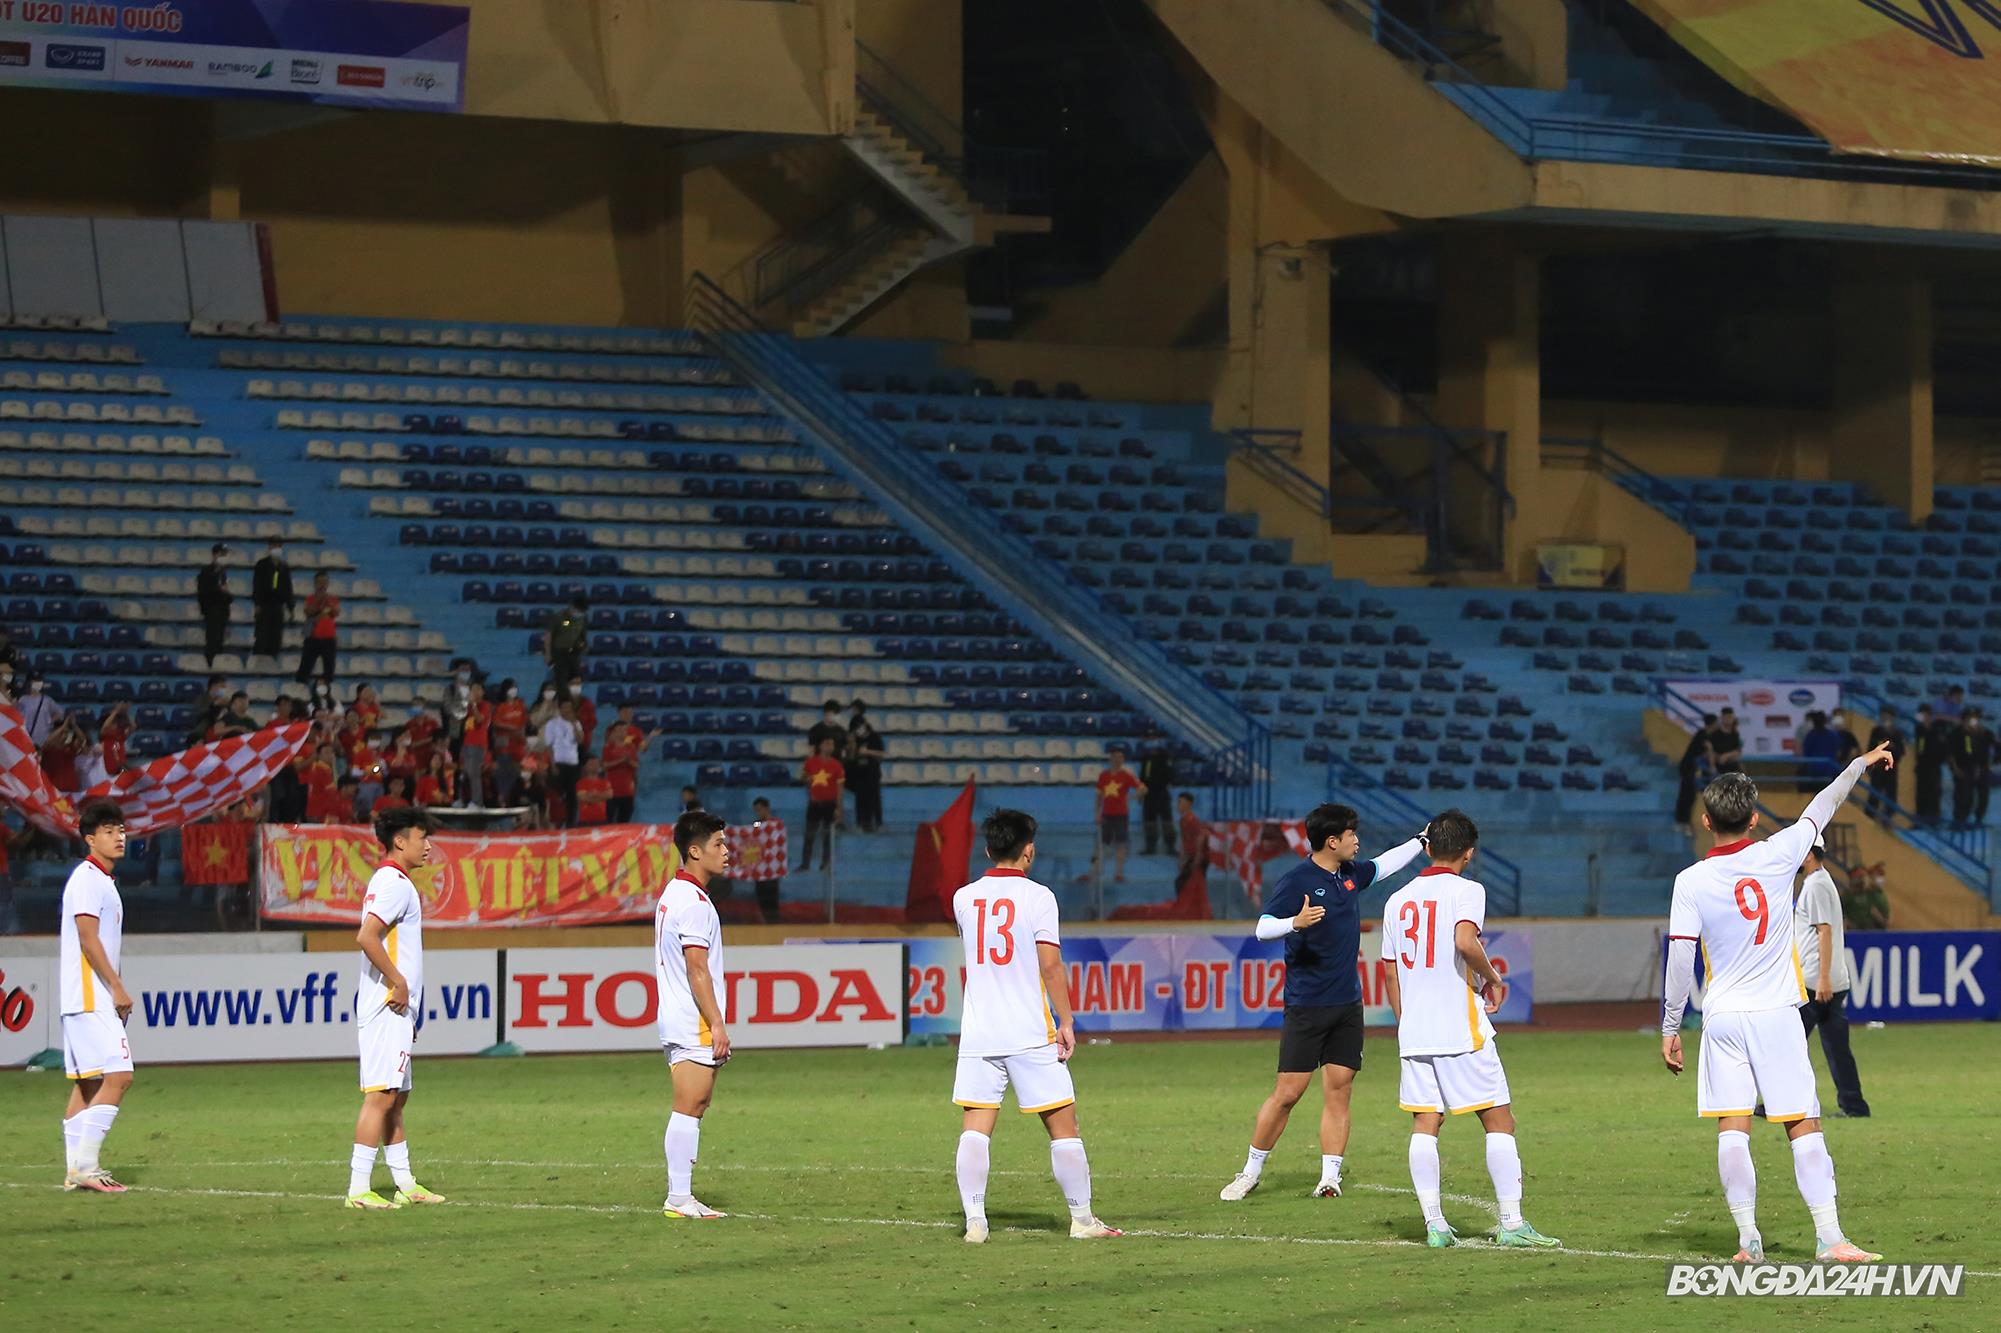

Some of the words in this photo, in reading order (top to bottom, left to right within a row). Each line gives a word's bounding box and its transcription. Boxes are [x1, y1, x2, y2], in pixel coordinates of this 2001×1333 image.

[22, 3, 63, 25] U20
[70, 4, 116, 28] HÀN
[123, 2, 183, 33] QUỐC
[145, 57, 194, 70] YANMAR
[207, 61, 257, 74] BAMBOO
[973, 898, 1016, 966] 13
[1400, 900, 1438, 970] 31
[1734, 877, 1769, 946] 9
[142, 970, 490, 1032] www.vff..vn
[512, 970, 896, 1028] HODA
[1184, 962, 1230, 1010] ĐT
[1240, 961, 1285, 1010] U2
[1844, 944, 1986, 1009] MILK
[120, 1037, 130, 1060] 5
